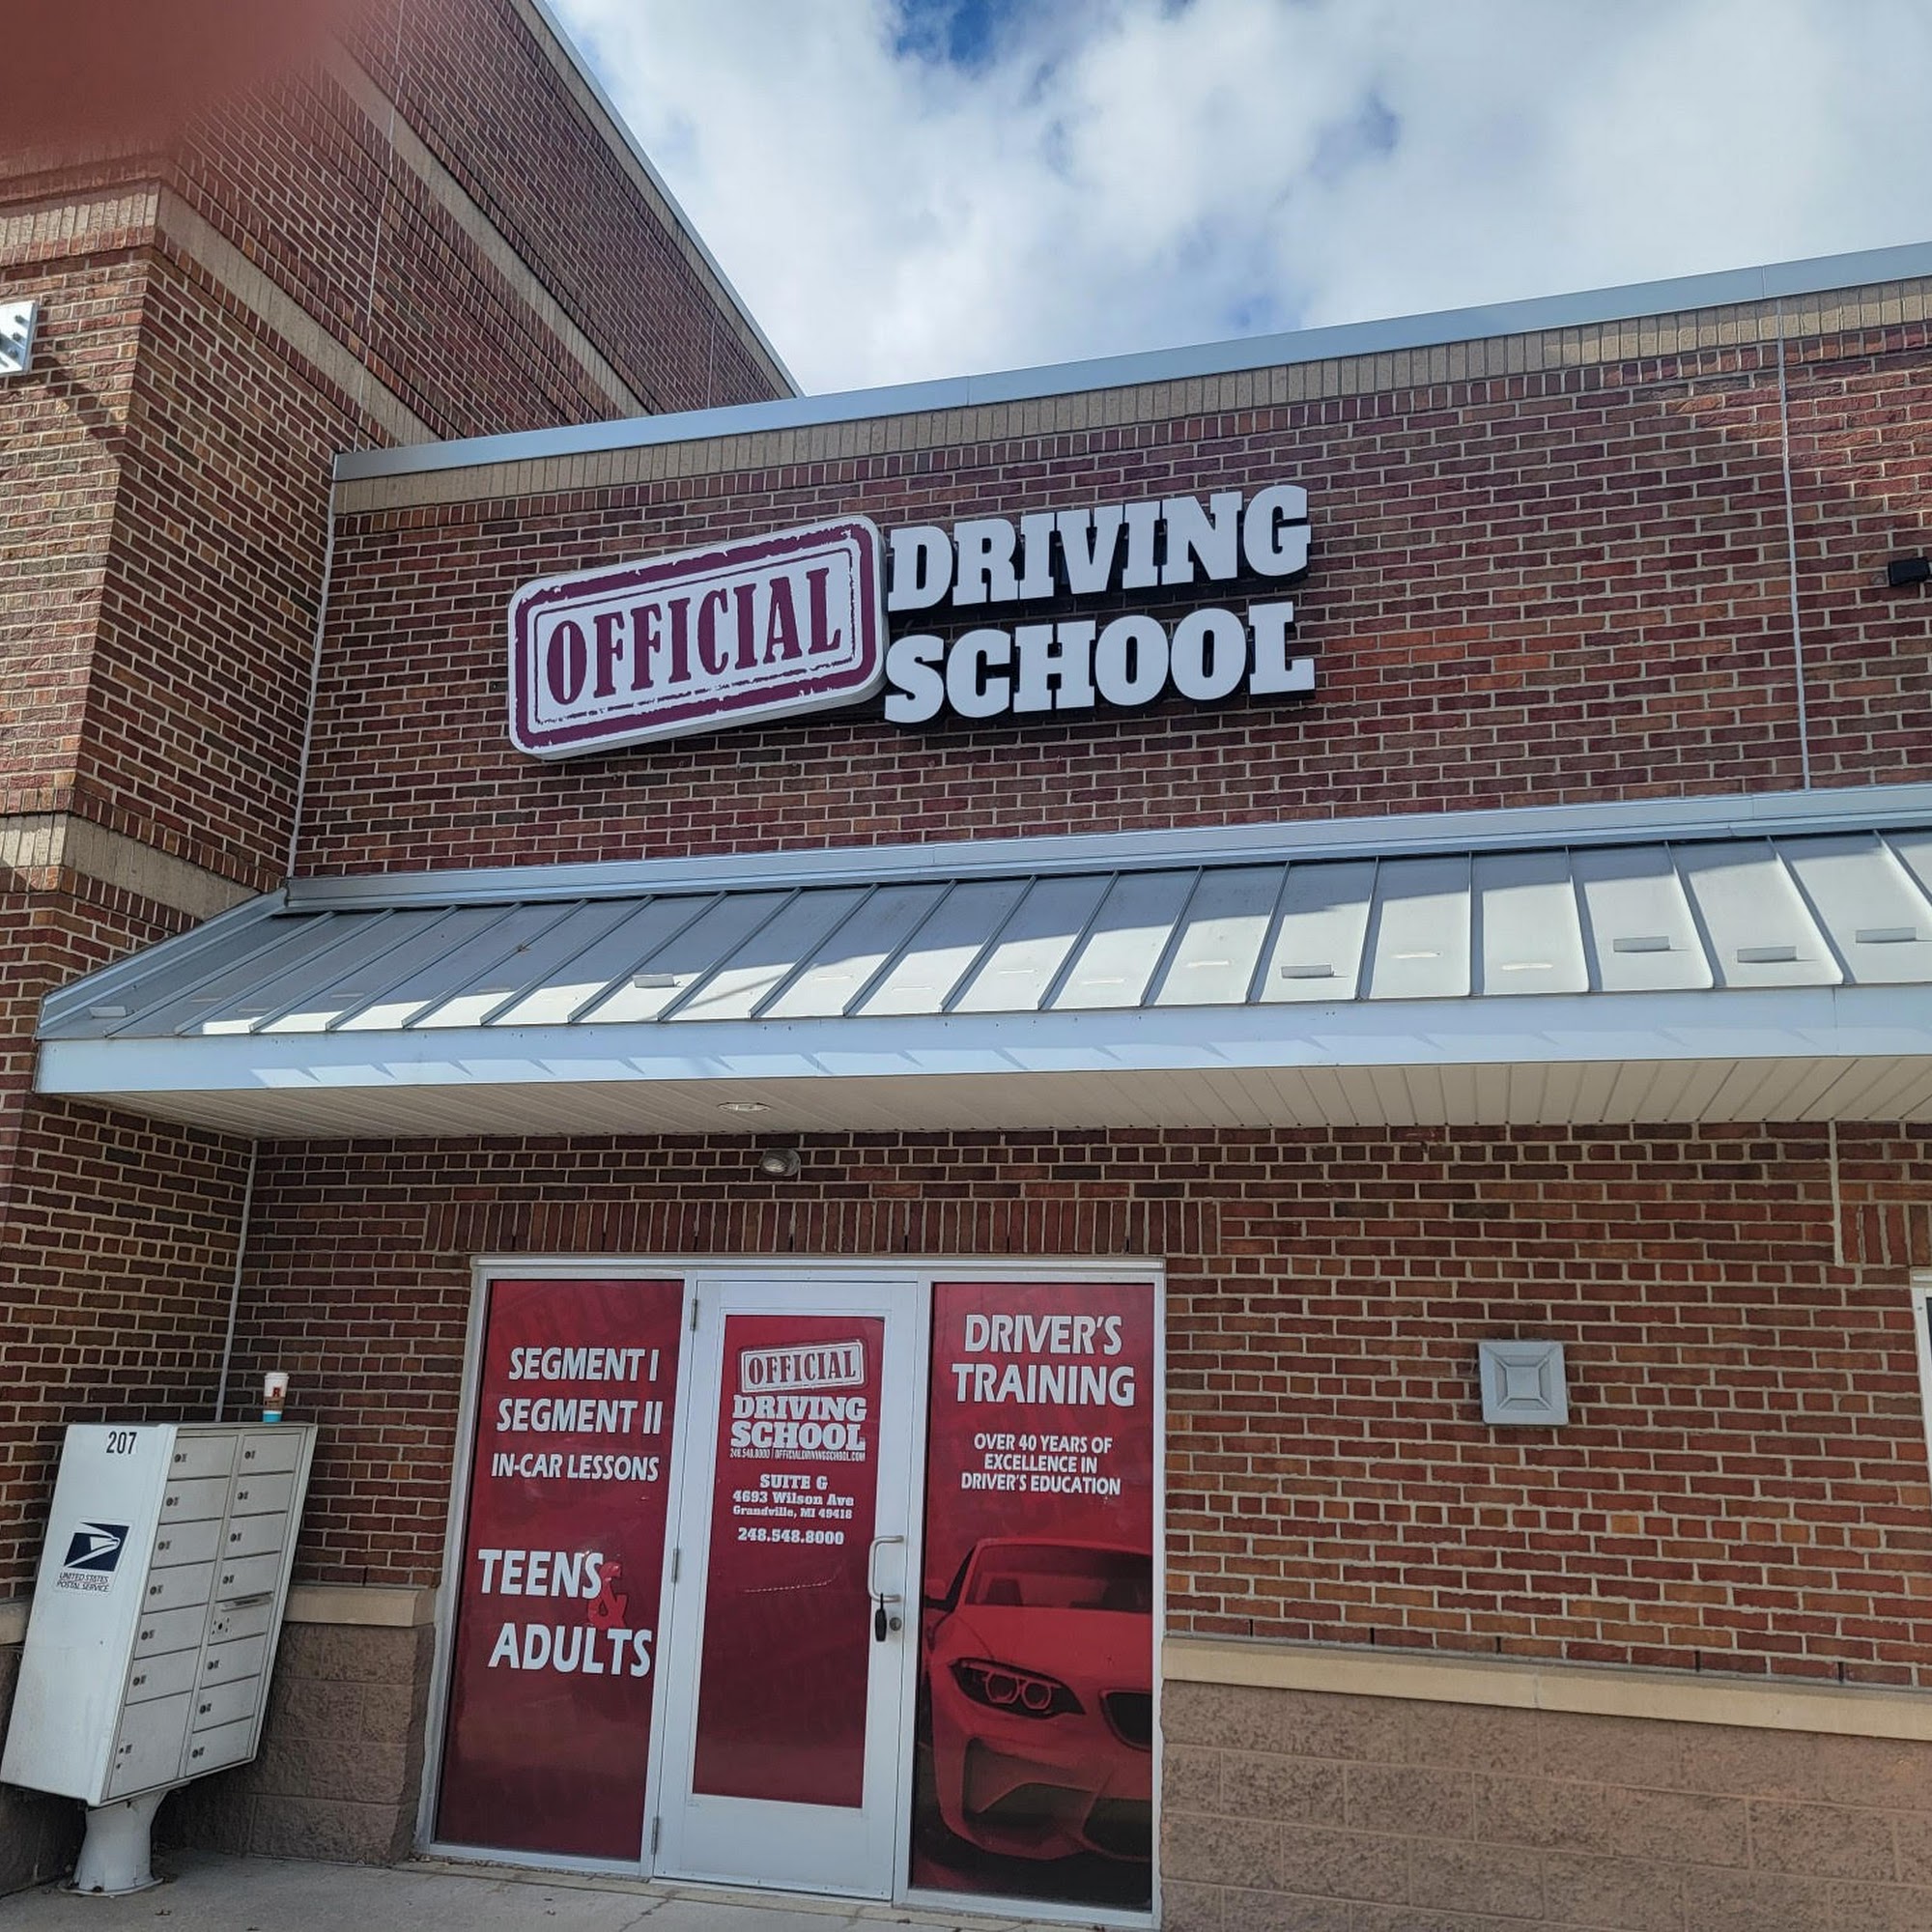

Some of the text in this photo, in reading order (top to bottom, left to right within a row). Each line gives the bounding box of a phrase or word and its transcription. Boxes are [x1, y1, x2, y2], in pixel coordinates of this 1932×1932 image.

[888, 484, 1312, 611] DRIVING
[546, 565, 841, 706] OFFICIAL
[884, 602, 1315, 724] SCHOOL
[964, 1314, 1122, 1355] DRIVER'S
[509, 1347, 659, 1381] SEGMENT I
[749, 1350, 856, 1384] OFFICIAL
[952, 1363, 1135, 1406] TRAINING
[497, 1398, 663, 1435] SEGMENT II
[732, 1394, 867, 1422] DRIVING
[106, 1431, 137, 1455] 207
[730, 1420, 866, 1451] SCHOOL
[974, 1434, 1112, 1453] OVER 40 YEARS OF
[491, 1453, 660, 1482] IN-CAR LESSONS
[984, 1454, 1097, 1473] EXCELLENCE IN
[760, 1474, 828, 1491] SUITE G
[961, 1473, 1121, 1495] DRIVER'S EDUCATION
[732, 1490, 854, 1506] 4693 Wilson Ave
[733, 1505, 852, 1520] Grandville, MI 49418
[738, 1527, 844, 1545] 248.548.8000
[56, 1579, 109, 1593] POSTAL SERVICE
[59, 1572, 109, 1583] UNITED STATES
[478, 1548, 604, 1599] TEENS
[588, 1562, 627, 1631] &
[488, 1623, 652, 1677] ADULTS
